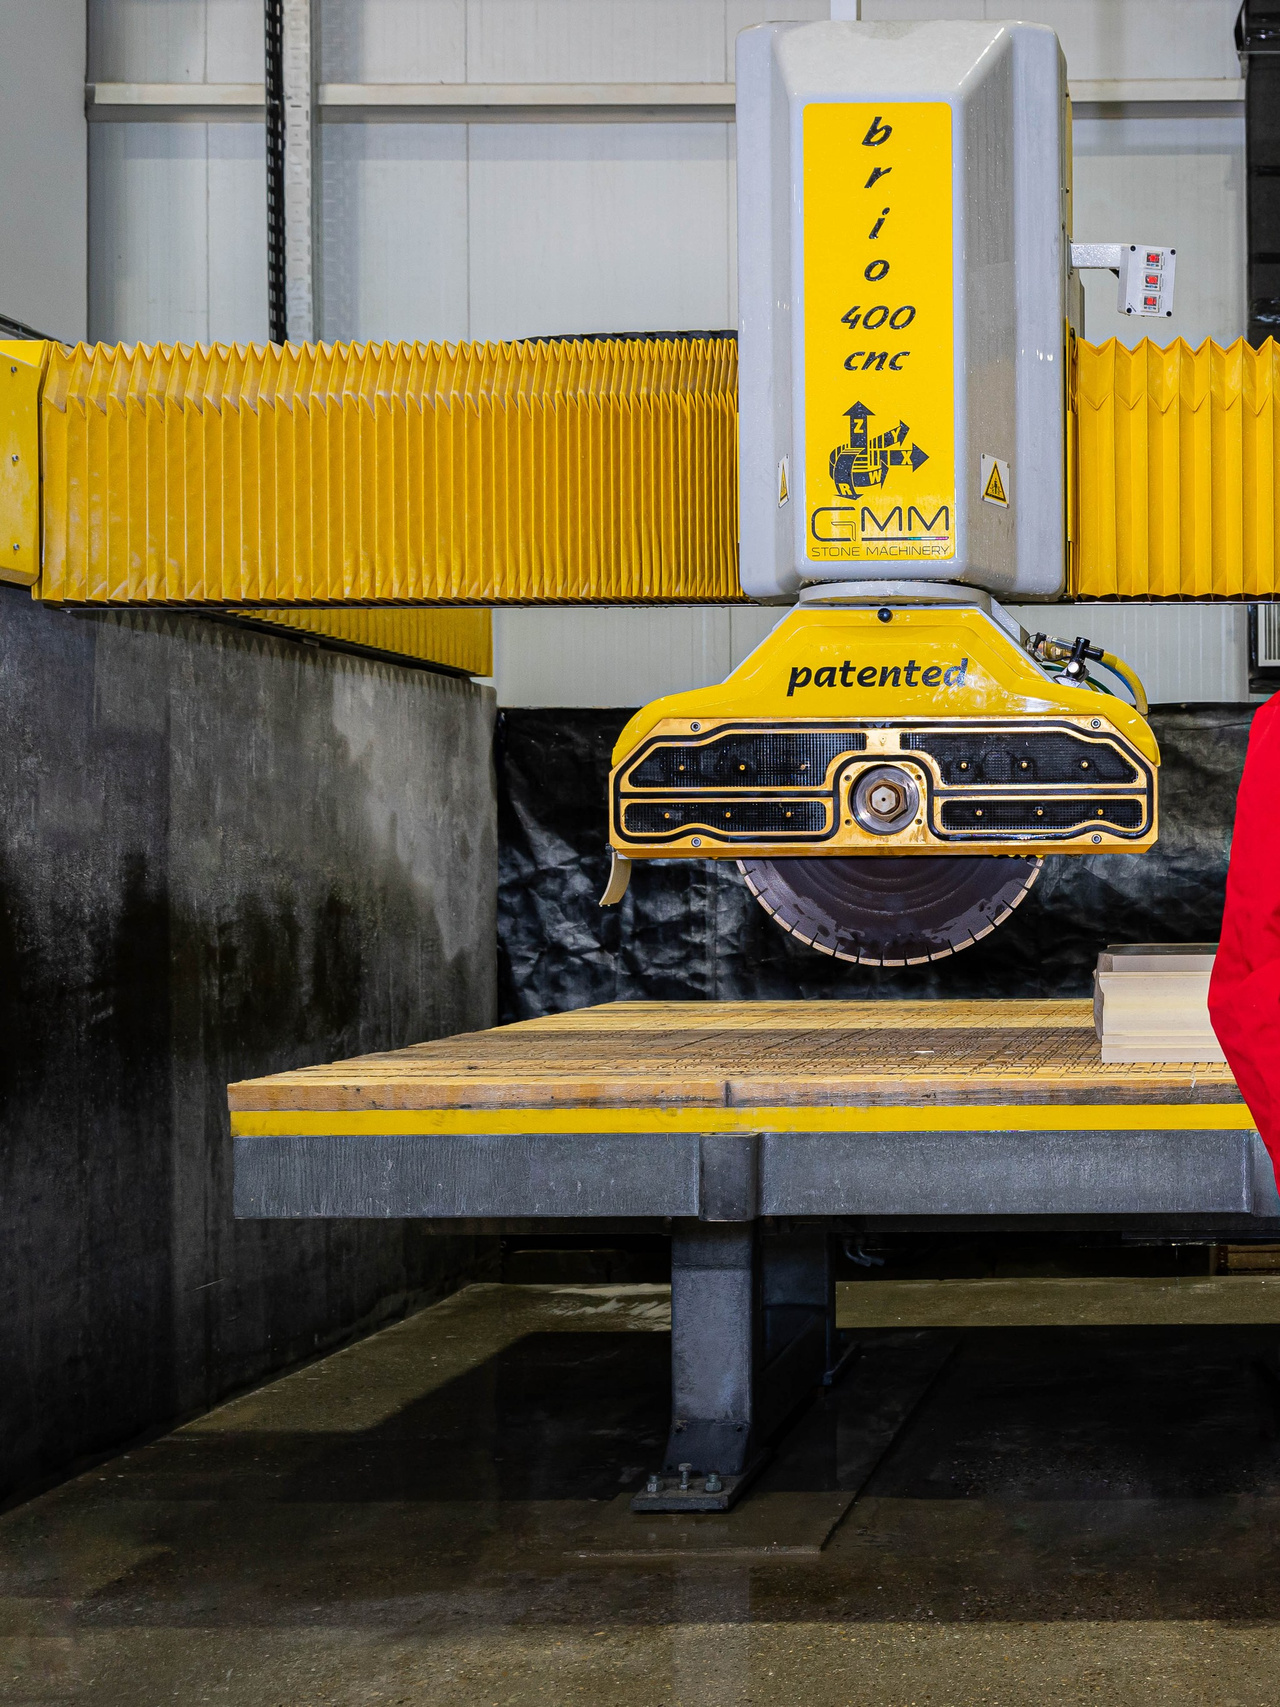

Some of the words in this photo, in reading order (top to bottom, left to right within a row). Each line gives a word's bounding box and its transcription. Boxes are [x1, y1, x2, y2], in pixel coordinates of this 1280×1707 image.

[861, 116, 893, 282] brio
[840, 305, 916, 330] 400
[843, 351, 911, 371] cnc
[853, 418, 864, 434] Z
[891, 426, 902, 443] Y
[901, 450, 913, 465] X
[868, 469, 882, 485] W
[838, 483, 852, 496] R
[811, 506, 949, 542] GMM
[811, 547, 860, 557] STONE
[866, 545, 950, 556] MACHINERY
[786, 657, 969, 697] patented
